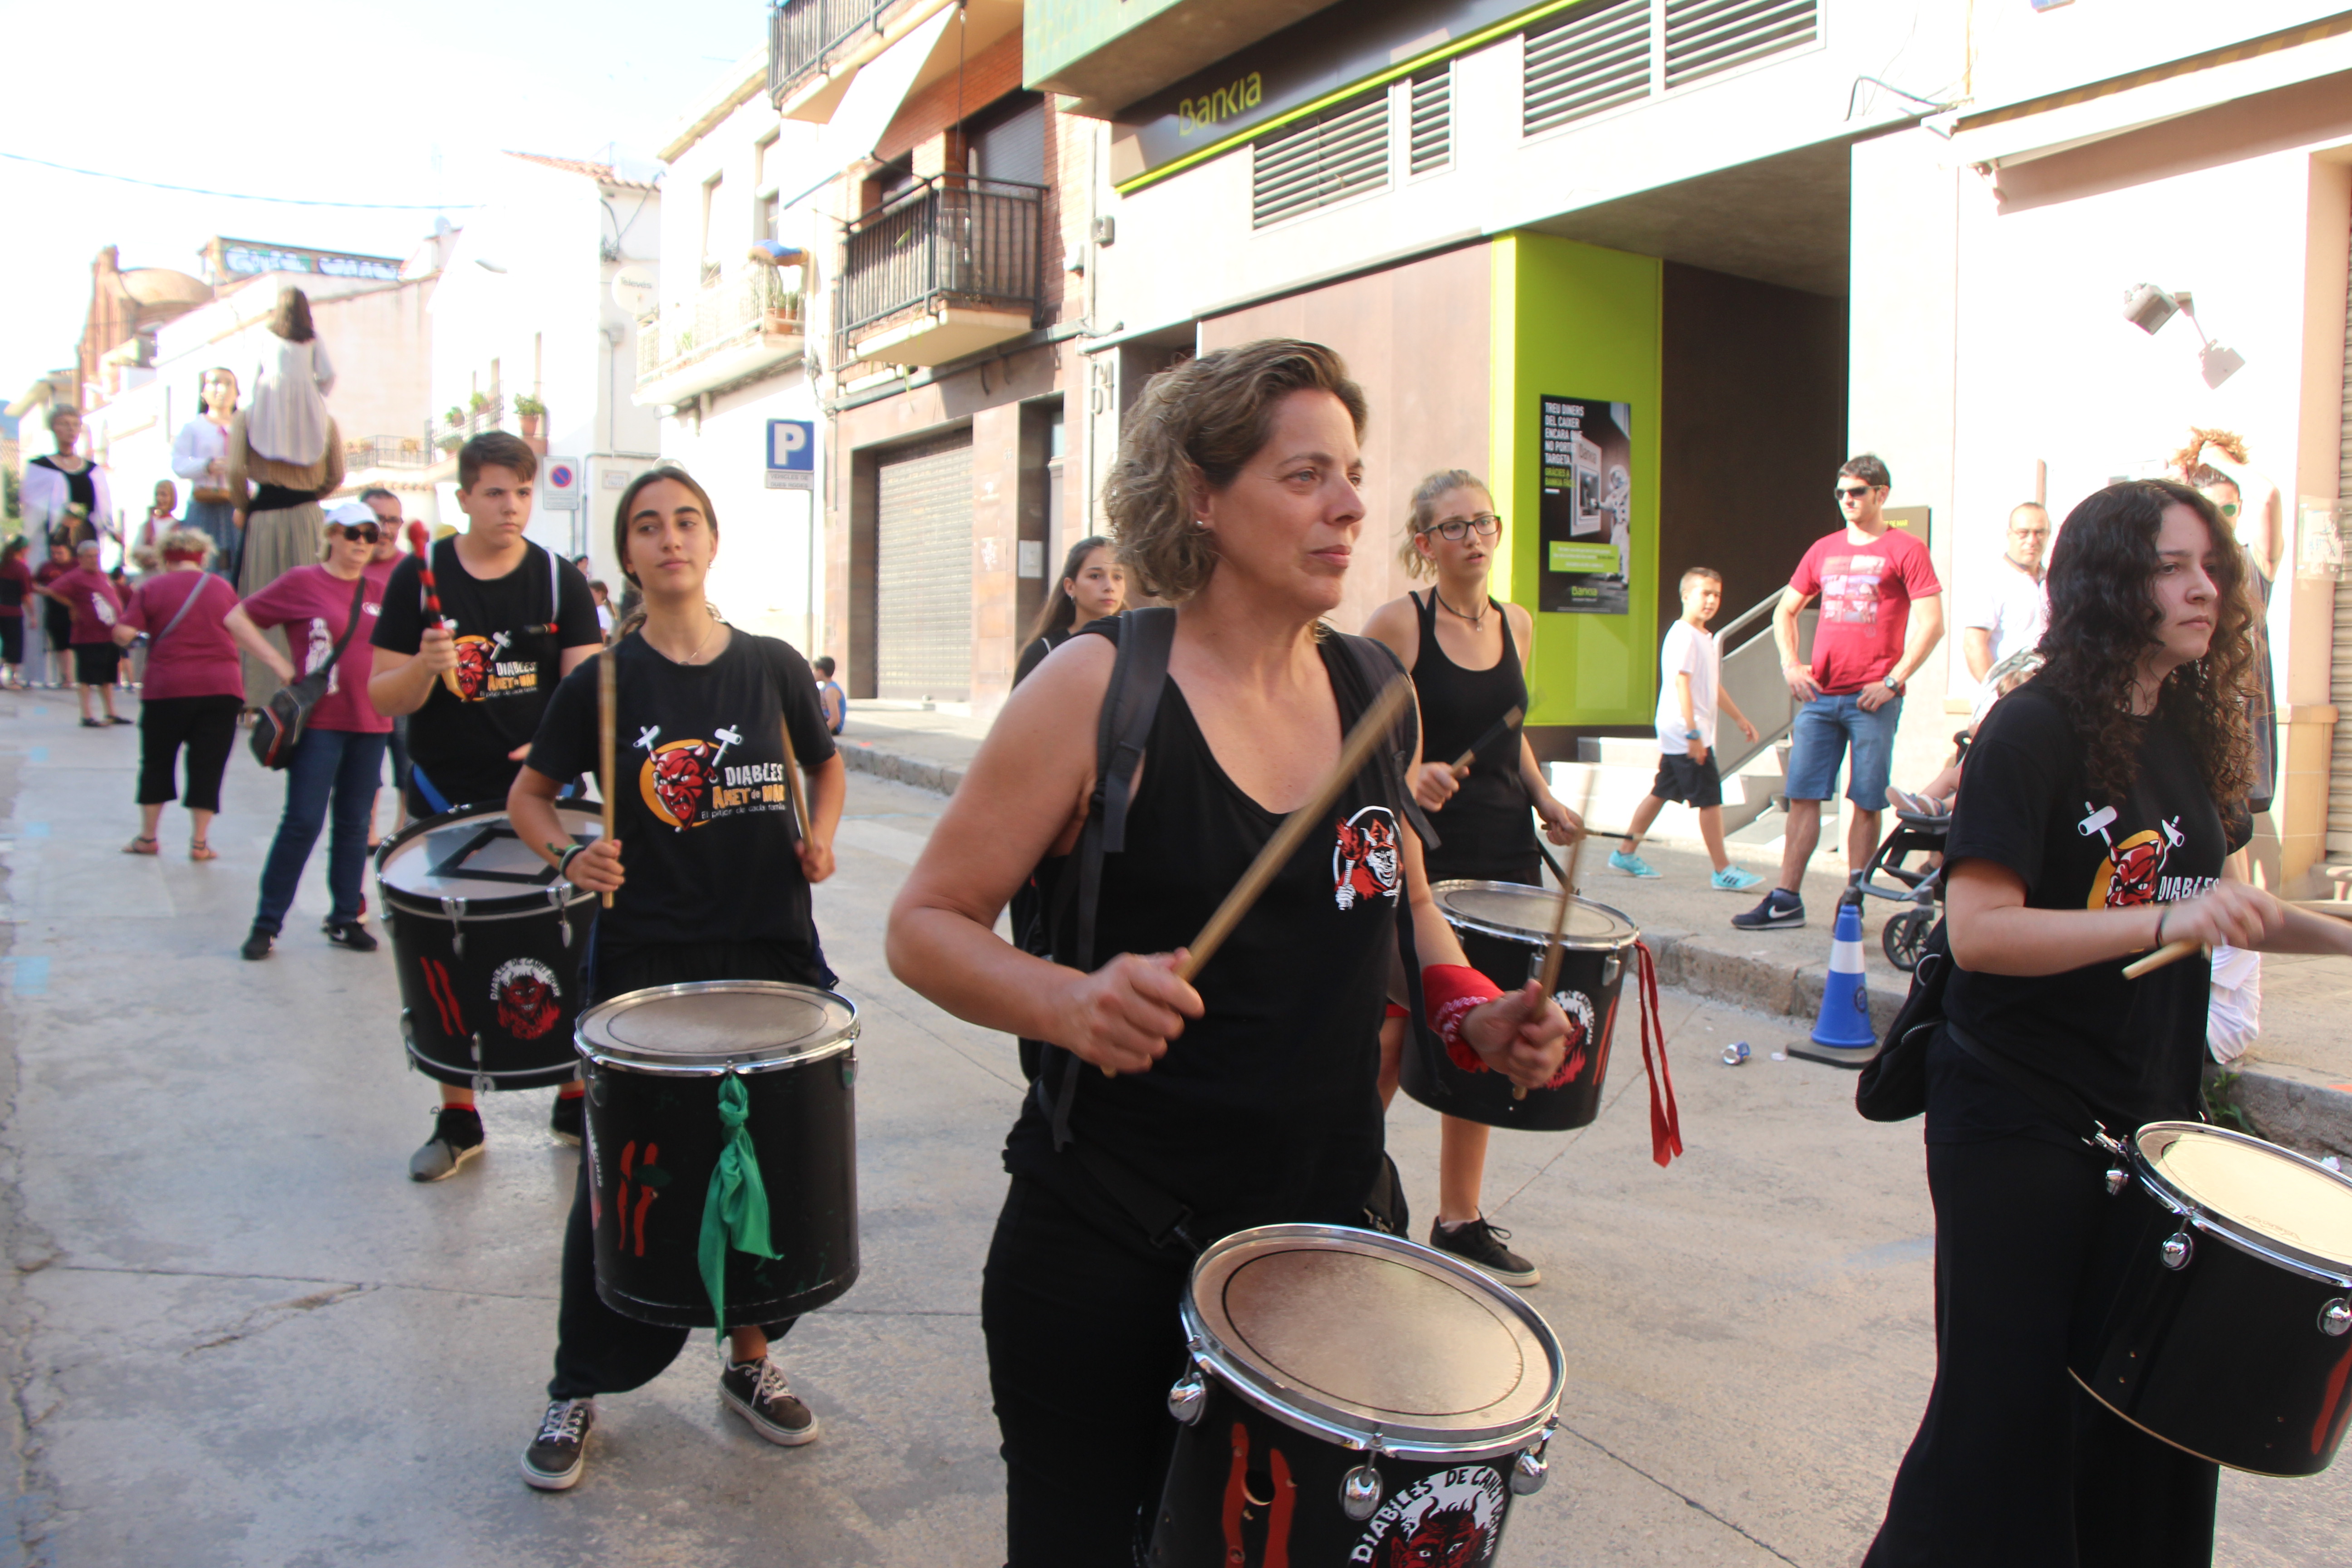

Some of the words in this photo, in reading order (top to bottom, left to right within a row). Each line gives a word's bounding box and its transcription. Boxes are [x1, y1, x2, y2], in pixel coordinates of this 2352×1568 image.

[1179, 71, 1262, 136] Bankia
[1545, 402, 1561, 414] TREU
[1562, 404, 1585, 416] DINERS
[1545, 415, 1557, 426] DEL
[1558, 416, 1580, 428] CAIXER
[1545, 427, 1570, 439] ENCARA
[774, 423, 805, 465] P
[1545, 440, 1554, 451] NO
[495, 662, 537, 676] DIABLES
[725, 763, 784, 786] DIABLES
[751, 789, 760, 799] de
[701, 811, 709, 819] El
[711, 809, 732, 818] pitjor
[2157, 876, 2219, 901] DIABLES
[490, 965, 508, 1000] DIABLES
[511, 958, 522, 967] DE
[1352, 1477, 1433, 1563] DIABLES
[1444, 1468, 1470, 1488] DE
[1470, 1466, 1503, 1504] CANET
